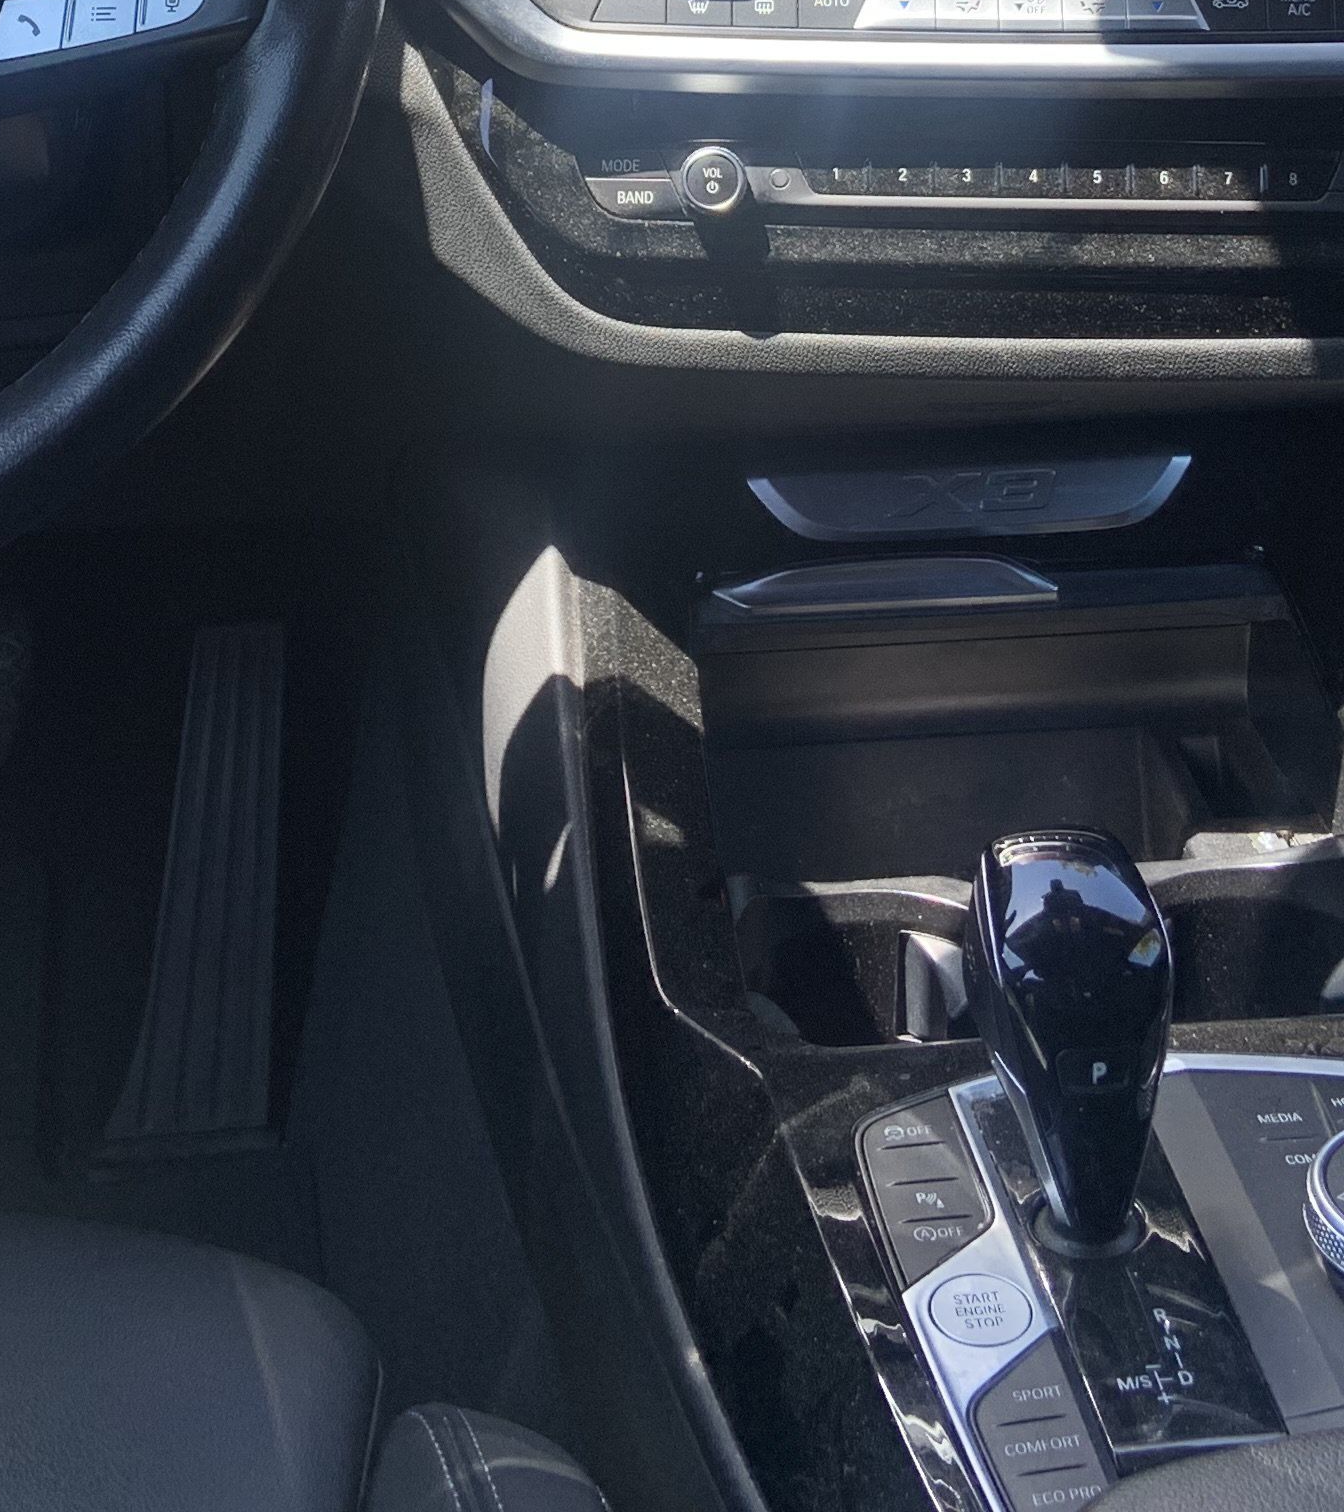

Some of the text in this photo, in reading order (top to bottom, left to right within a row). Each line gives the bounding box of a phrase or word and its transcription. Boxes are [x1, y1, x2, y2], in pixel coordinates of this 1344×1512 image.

[1288, 3, 1311, 16] A/C
[601, 159, 641, 172] MODE
[703, 167, 723, 179] VOL
[832, 167, 840, 180] 1
[898, 168, 907, 182] 2
[962, 168, 971, 182] 3
[1028, 168, 1038, 183] 4
[1092, 169, 1102, 184] 5
[1159, 170, 1169, 185] 6
[1224, 171, 1233, 185] 7
[1288, 172, 1298, 186] 8
[617, 190, 654, 204] BAND
[885, 468, 1056, 519] X3
[1092, 1061, 1107, 1085] P
[1257, 1112, 1303, 1124] MEDIA
[906, 1125, 933, 1137] OFF
[953, 1291, 1000, 1306] START
[955, 1303, 1007, 1317] ENGINE
[1153, 1308, 1167, 1322] R
[964, 1317, 1005, 1329] STOP
[1164, 1335, 1182, 1351] N
[1116, 1374, 1153, 1392] M/S
[1177, 1371, 1194, 1386] D
[1012, 1385, 1061, 1402] SPORT
[1004, 1434, 1081, 1457] COMFORT
[1032, 1489, 1066, 1507] ECO
